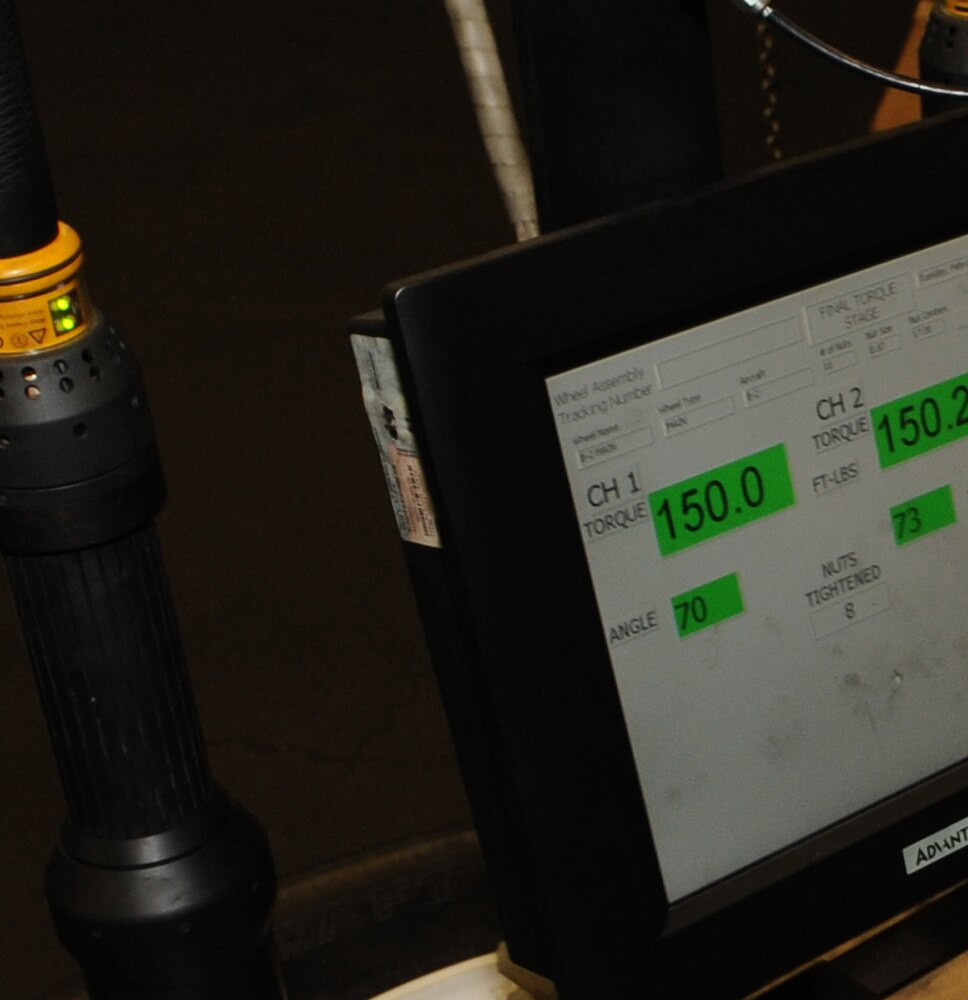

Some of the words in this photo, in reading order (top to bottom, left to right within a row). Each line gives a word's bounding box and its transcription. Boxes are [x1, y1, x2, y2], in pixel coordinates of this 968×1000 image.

[819, 299, 851, 319] FINAL
[854, 281, 897, 306] TORQUE
[845, 306, 880, 330] STAGE
[555, 386, 589, 408] Wheel
[593, 366, 645, 393] Assembly
[557, 401, 608, 426] Tracking
[609, 383, 652, 409] Number
[816, 393, 846, 421] CH
[851, 387, 864, 410] 2
[811, 416, 868, 450] TORQUE
[586, 478, 620, 507] CH
[627, 471, 640, 494] 1
[812, 463, 858, 493] FT-LBS
[584, 501, 648, 539] TORQUE
[657, 466, 765, 539] 150.0
[893, 507, 921, 539] 73
[822, 552, 858, 578] NUTS
[805, 565, 881, 607] TIGHTENED
[609, 611, 657, 643] ANGLE
[674, 596, 708, 631] 70
